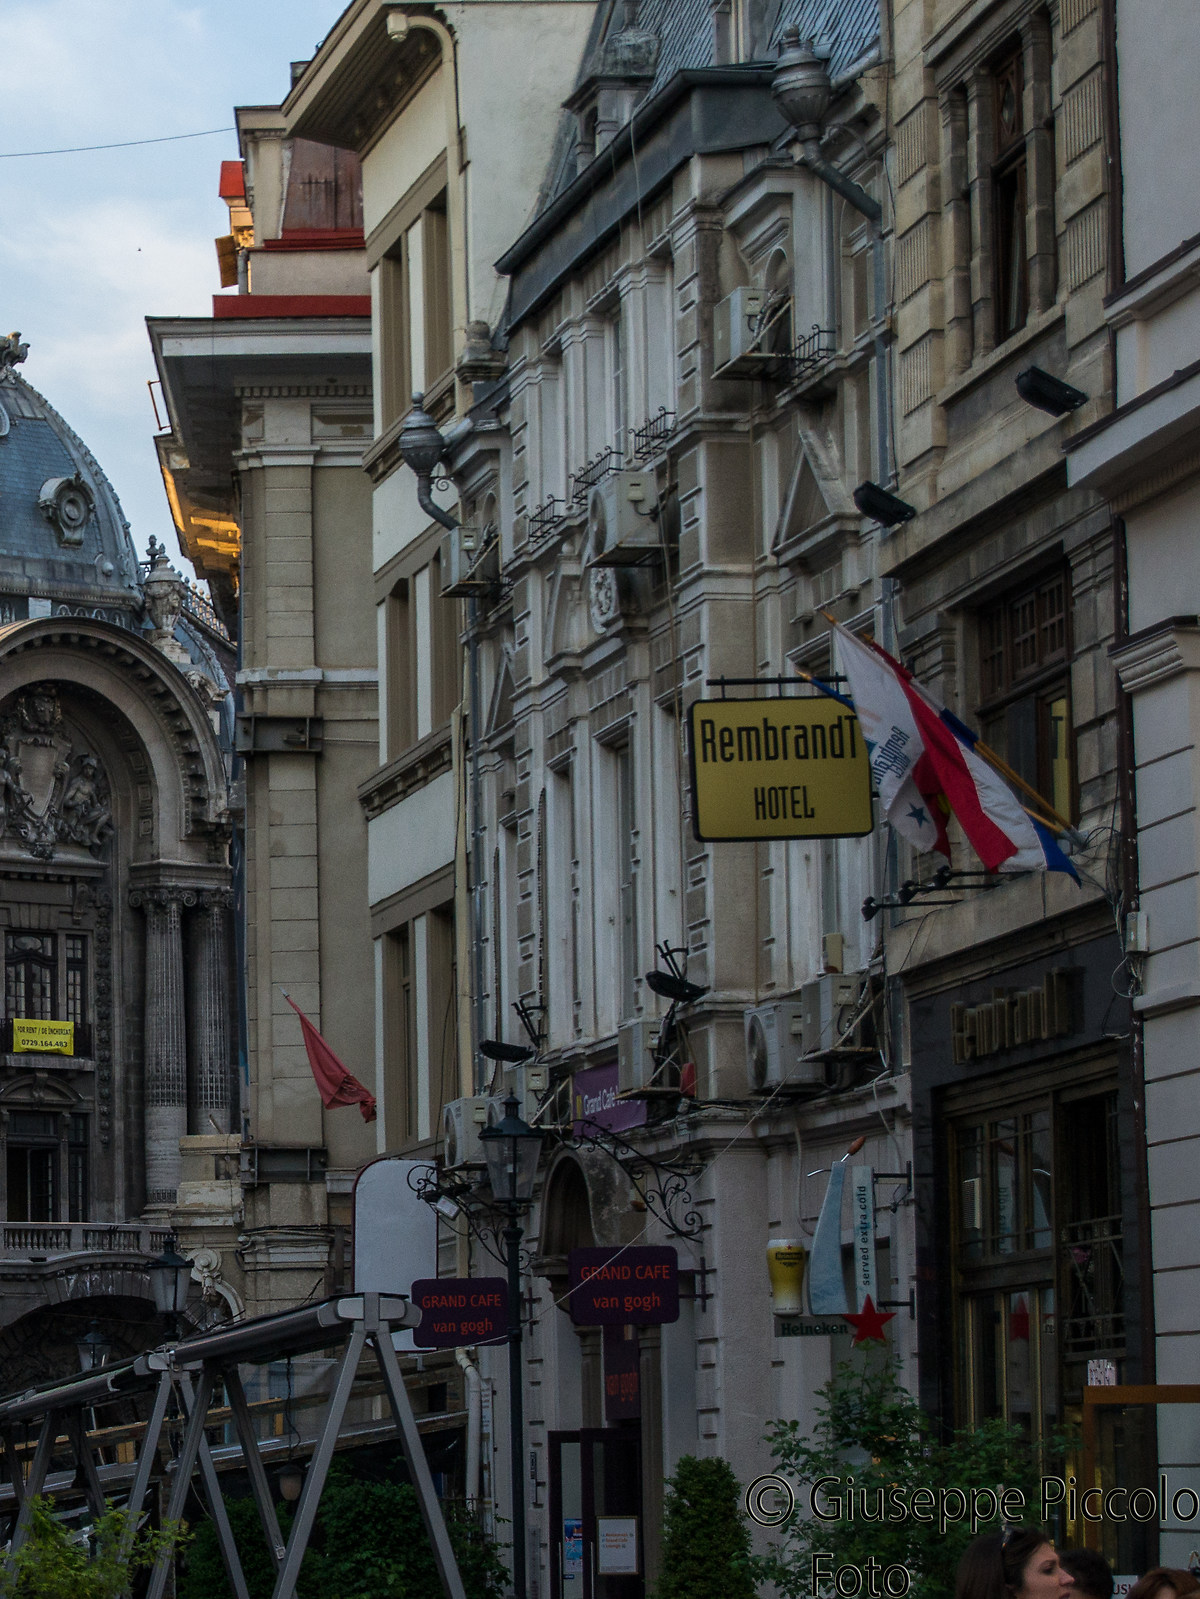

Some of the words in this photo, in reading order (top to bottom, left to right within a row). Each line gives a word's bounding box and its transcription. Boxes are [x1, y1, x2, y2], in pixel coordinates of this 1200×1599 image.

[754, 785, 815, 820] HOTEL
[26, 1026, 37, 1034] RENT
[41, 1027, 48, 1035] DE
[583, 1090, 602, 1116] Grand
[856, 1185, 867, 1210] cold
[860, 1214, 869, 1244] extra
[580, 1265, 632, 1281] GRAND
[635, 1264, 671, 1280] CAFE
[860, 1247, 871, 1286] served
[422, 1294, 467, 1309] GRAND
[470, 1293, 502, 1308] CAFE
[592, 1296, 619, 1309] van
[624, 1292, 662, 1312] gogh
[433, 1321, 456, 1334] van
[460, 1317, 494, 1336] gogh
[781, 1322, 850, 1336] Heineken
